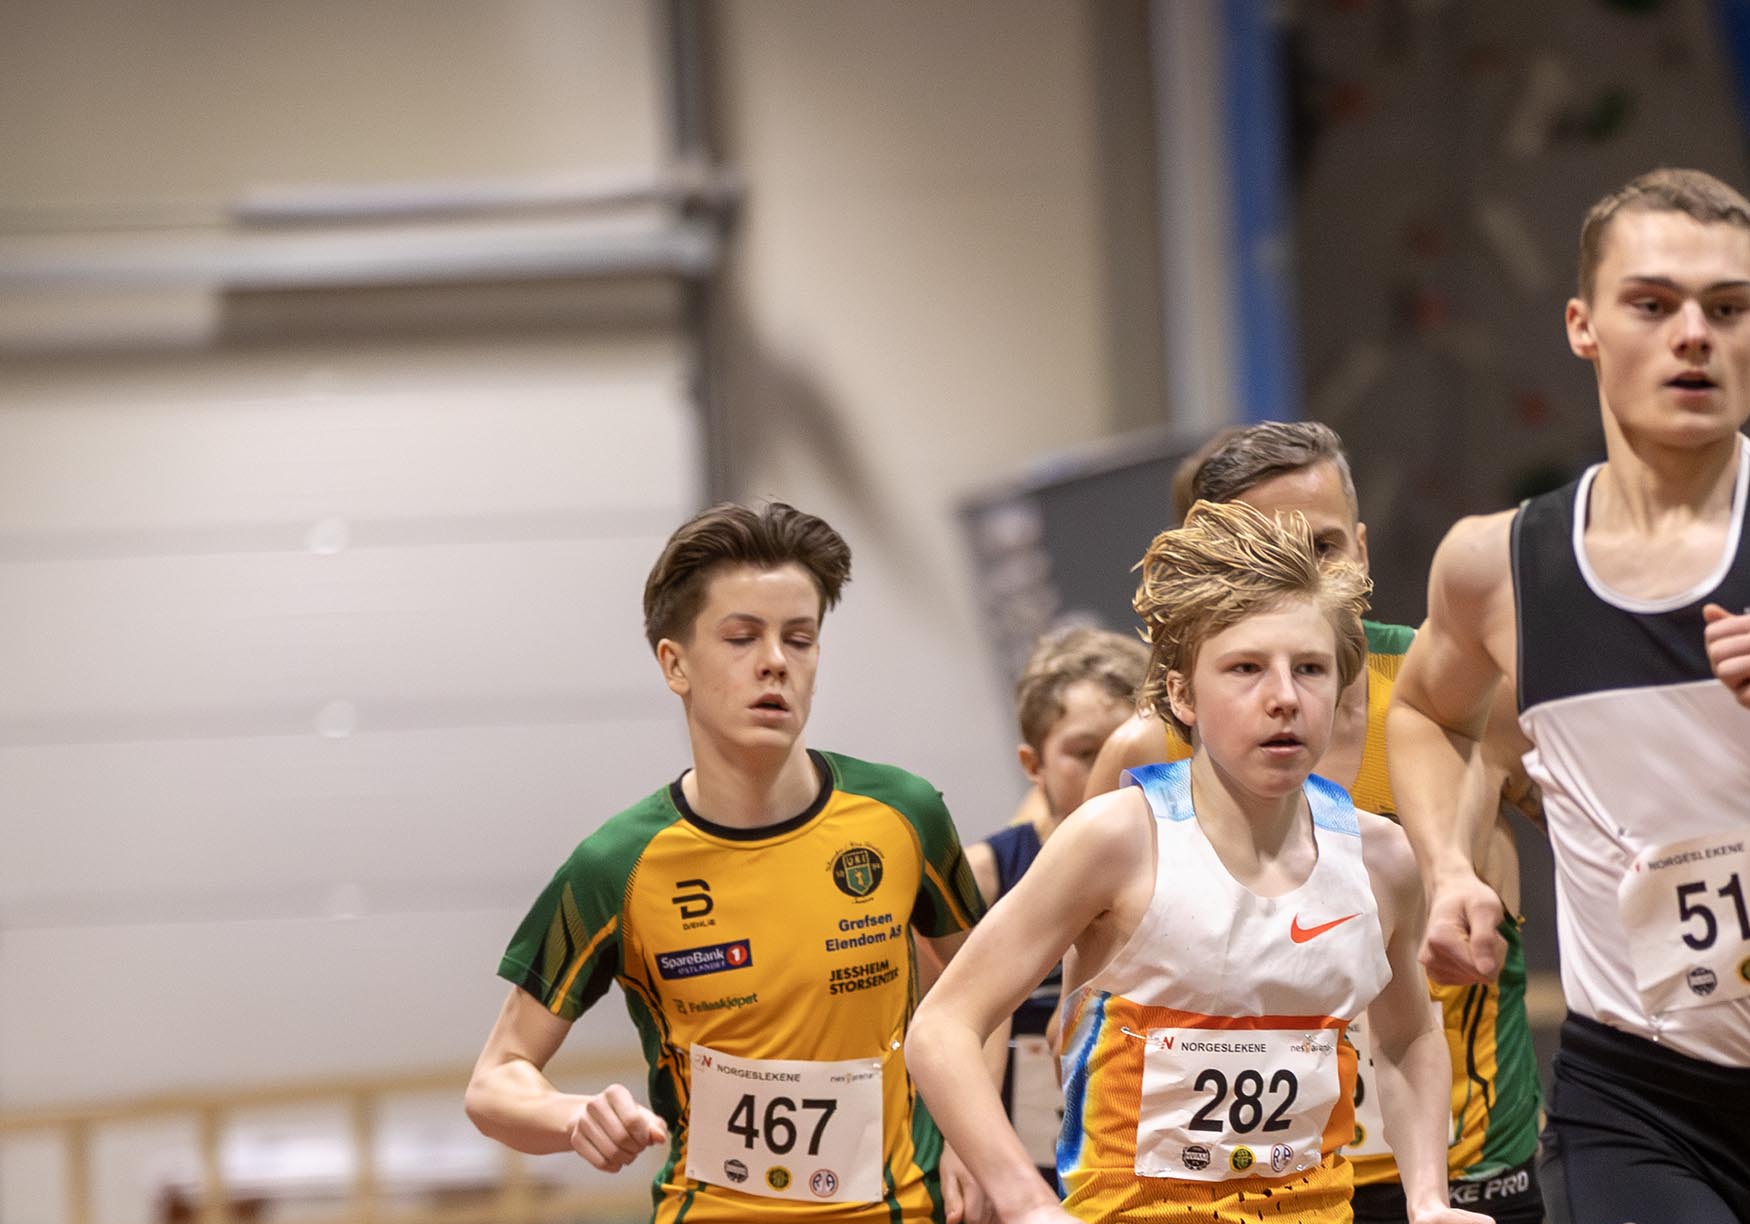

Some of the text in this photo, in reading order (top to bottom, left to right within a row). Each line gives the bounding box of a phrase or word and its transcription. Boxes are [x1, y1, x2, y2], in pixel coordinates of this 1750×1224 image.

[1648, 842, 1745, 871] NORGESLEKENE
[825, 933, 886, 952] Eiendom
[660, 948, 725, 969] SpareBank
[829, 959, 890, 983] JESSHEIM
[1181, 1041, 1267, 1053] NORGESLEKENE
[716, 1063, 800, 1083] NORGESLEKENE
[1188, 1068, 1299, 1134] 282
[727, 1093, 838, 1156] 467
[1450, 1170, 1530, 1204] KE PRO
